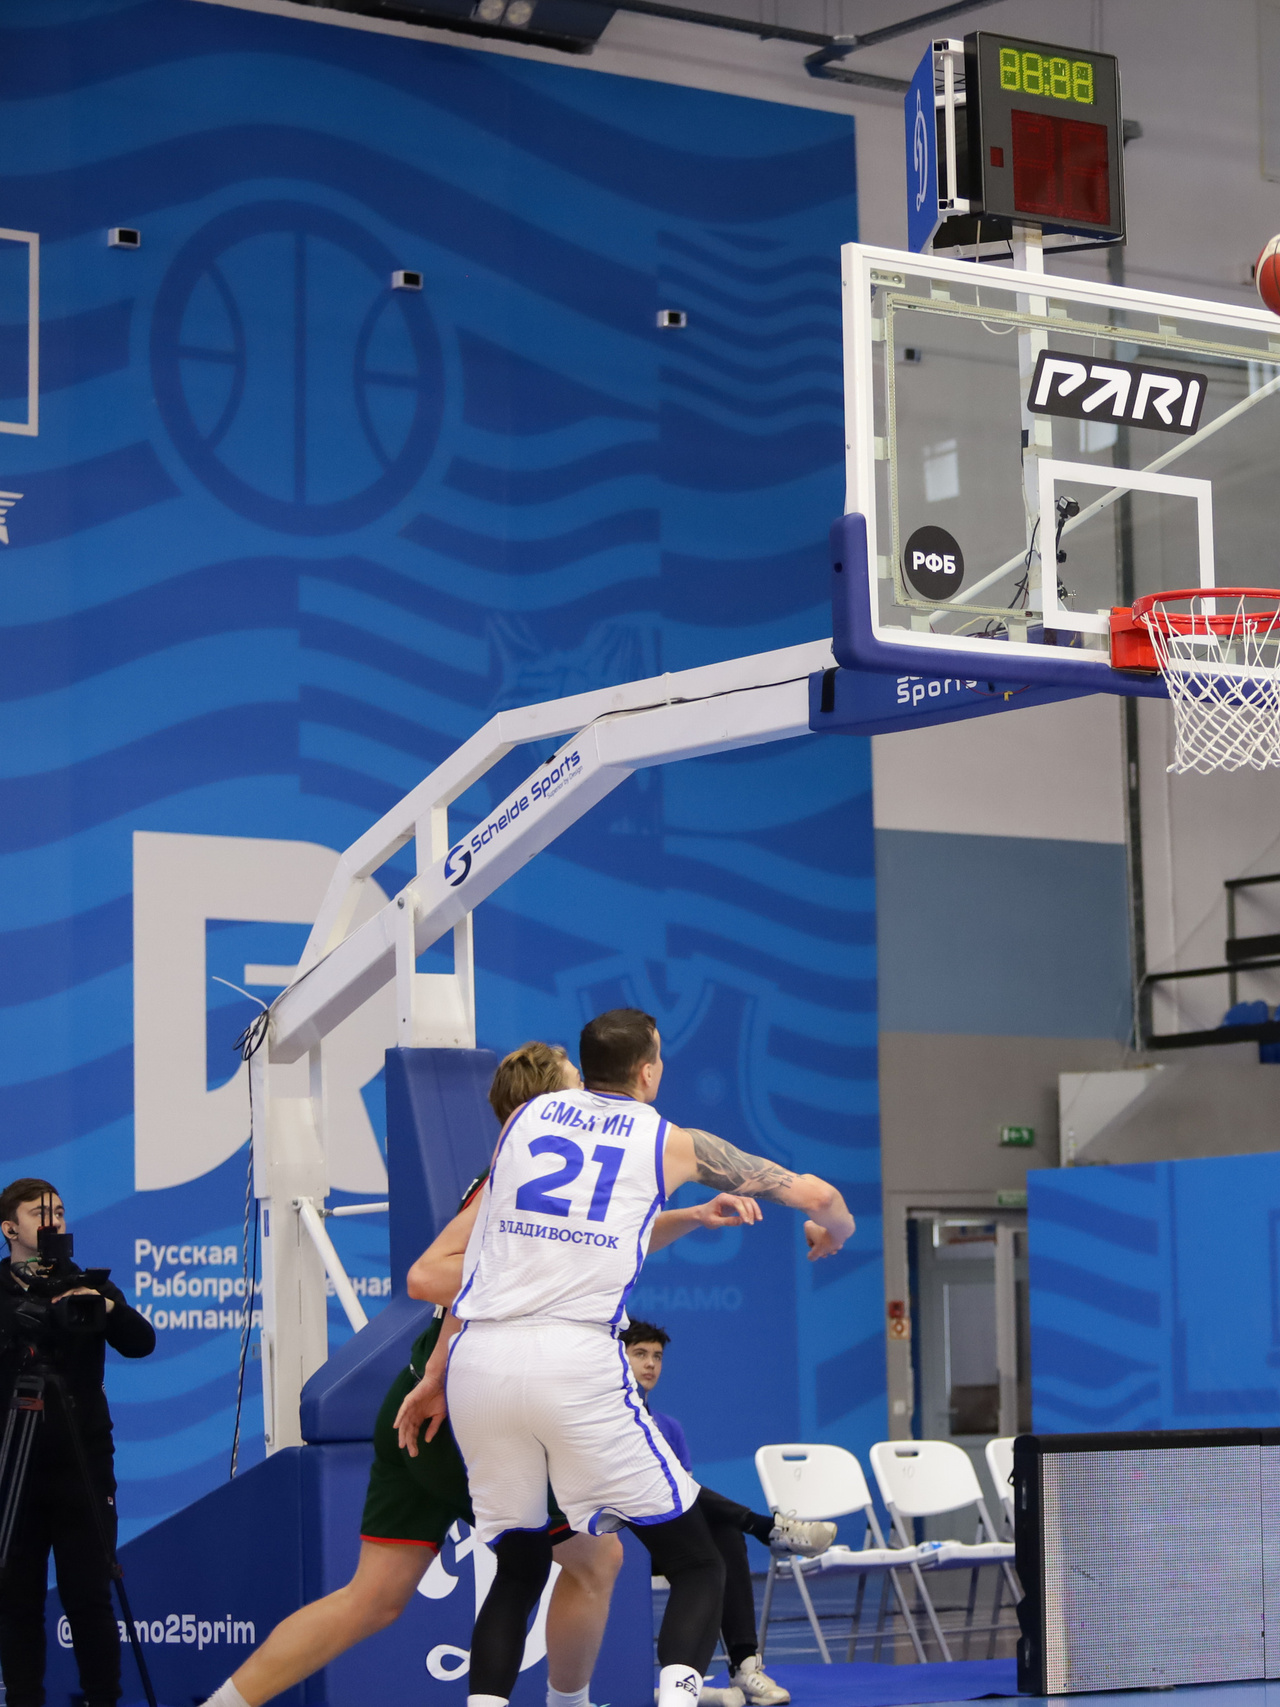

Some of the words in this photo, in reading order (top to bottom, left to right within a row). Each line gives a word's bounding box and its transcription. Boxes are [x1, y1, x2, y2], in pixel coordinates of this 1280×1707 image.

[1034, 358, 1200, 427] PARI
[912, 551, 956, 574] РФБ
[471, 796, 530, 854] Schelde
[531, 751, 581, 801] Sports
[515, 1135, 626, 1222] 21
[499, 1220, 620, 1249] ВЛАДИВОСТОК
[135, 1238, 238, 1272] Русская
[627, 1286, 743, 1312] ИНАМО
[57, 1614, 256, 1650] @amo25prim
